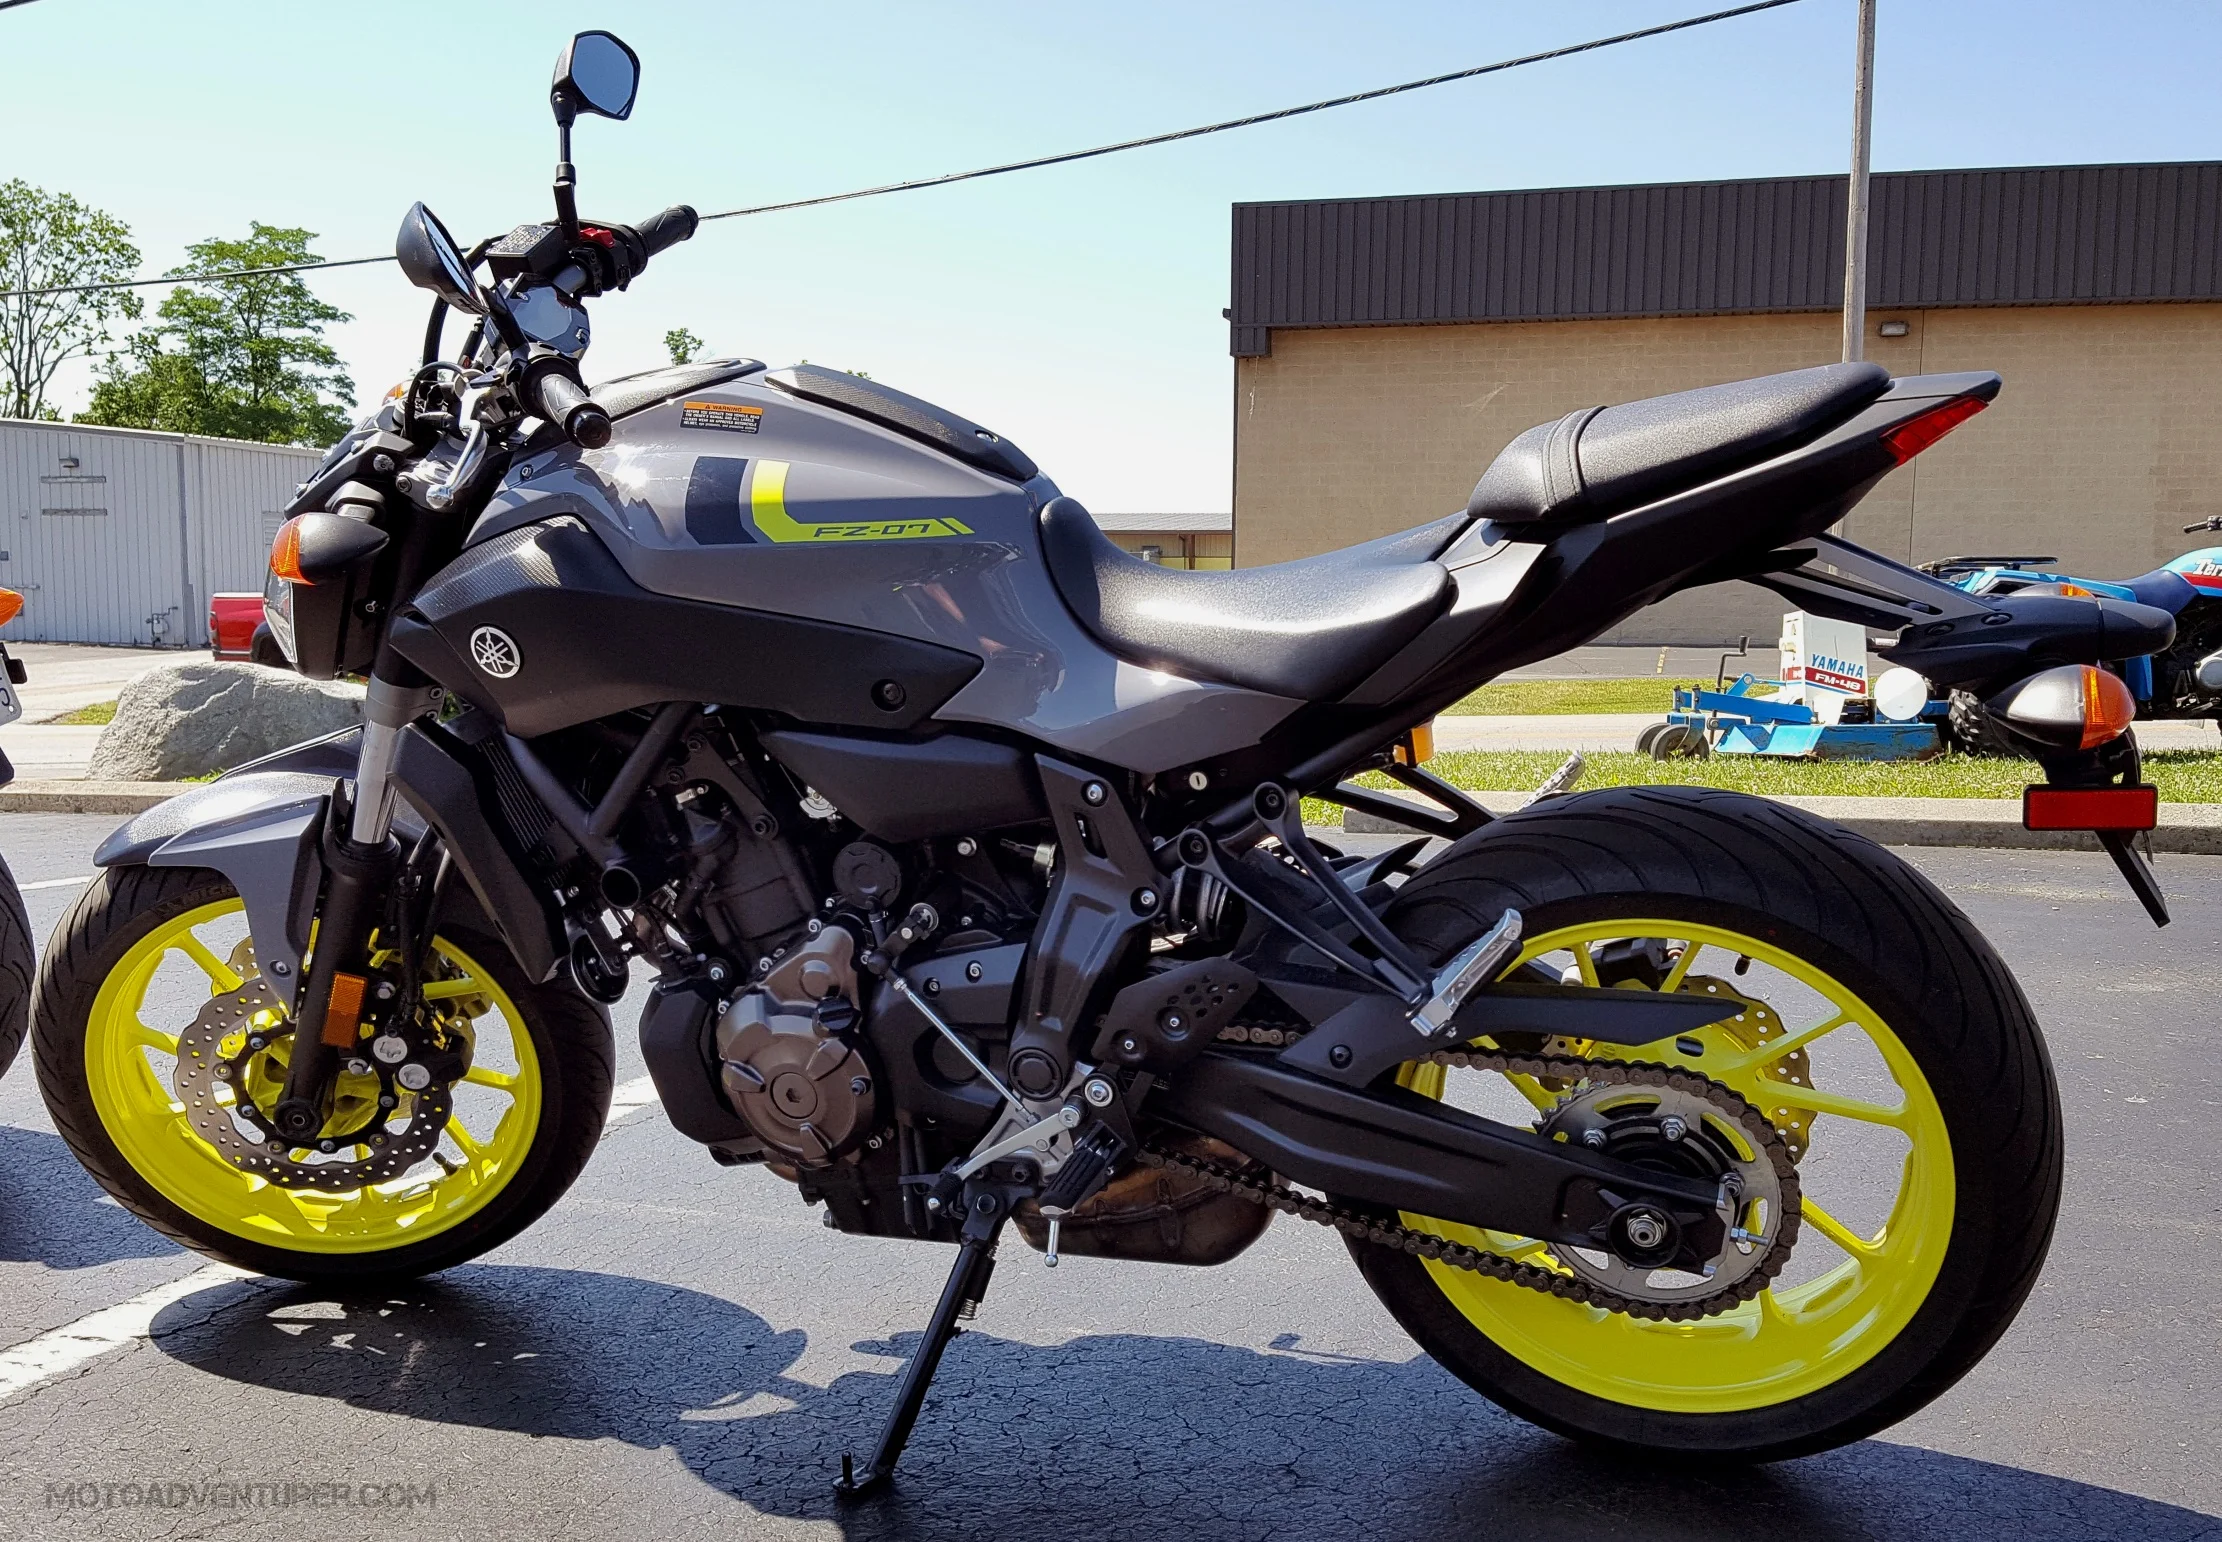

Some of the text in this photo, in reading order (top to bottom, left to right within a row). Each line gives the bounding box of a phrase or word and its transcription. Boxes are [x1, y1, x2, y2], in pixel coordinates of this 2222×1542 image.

[813, 523, 930, 538] FZ-07
[2192, 558, 2222, 577] Ter
[1812, 653, 1864, 678] YAMAHA
